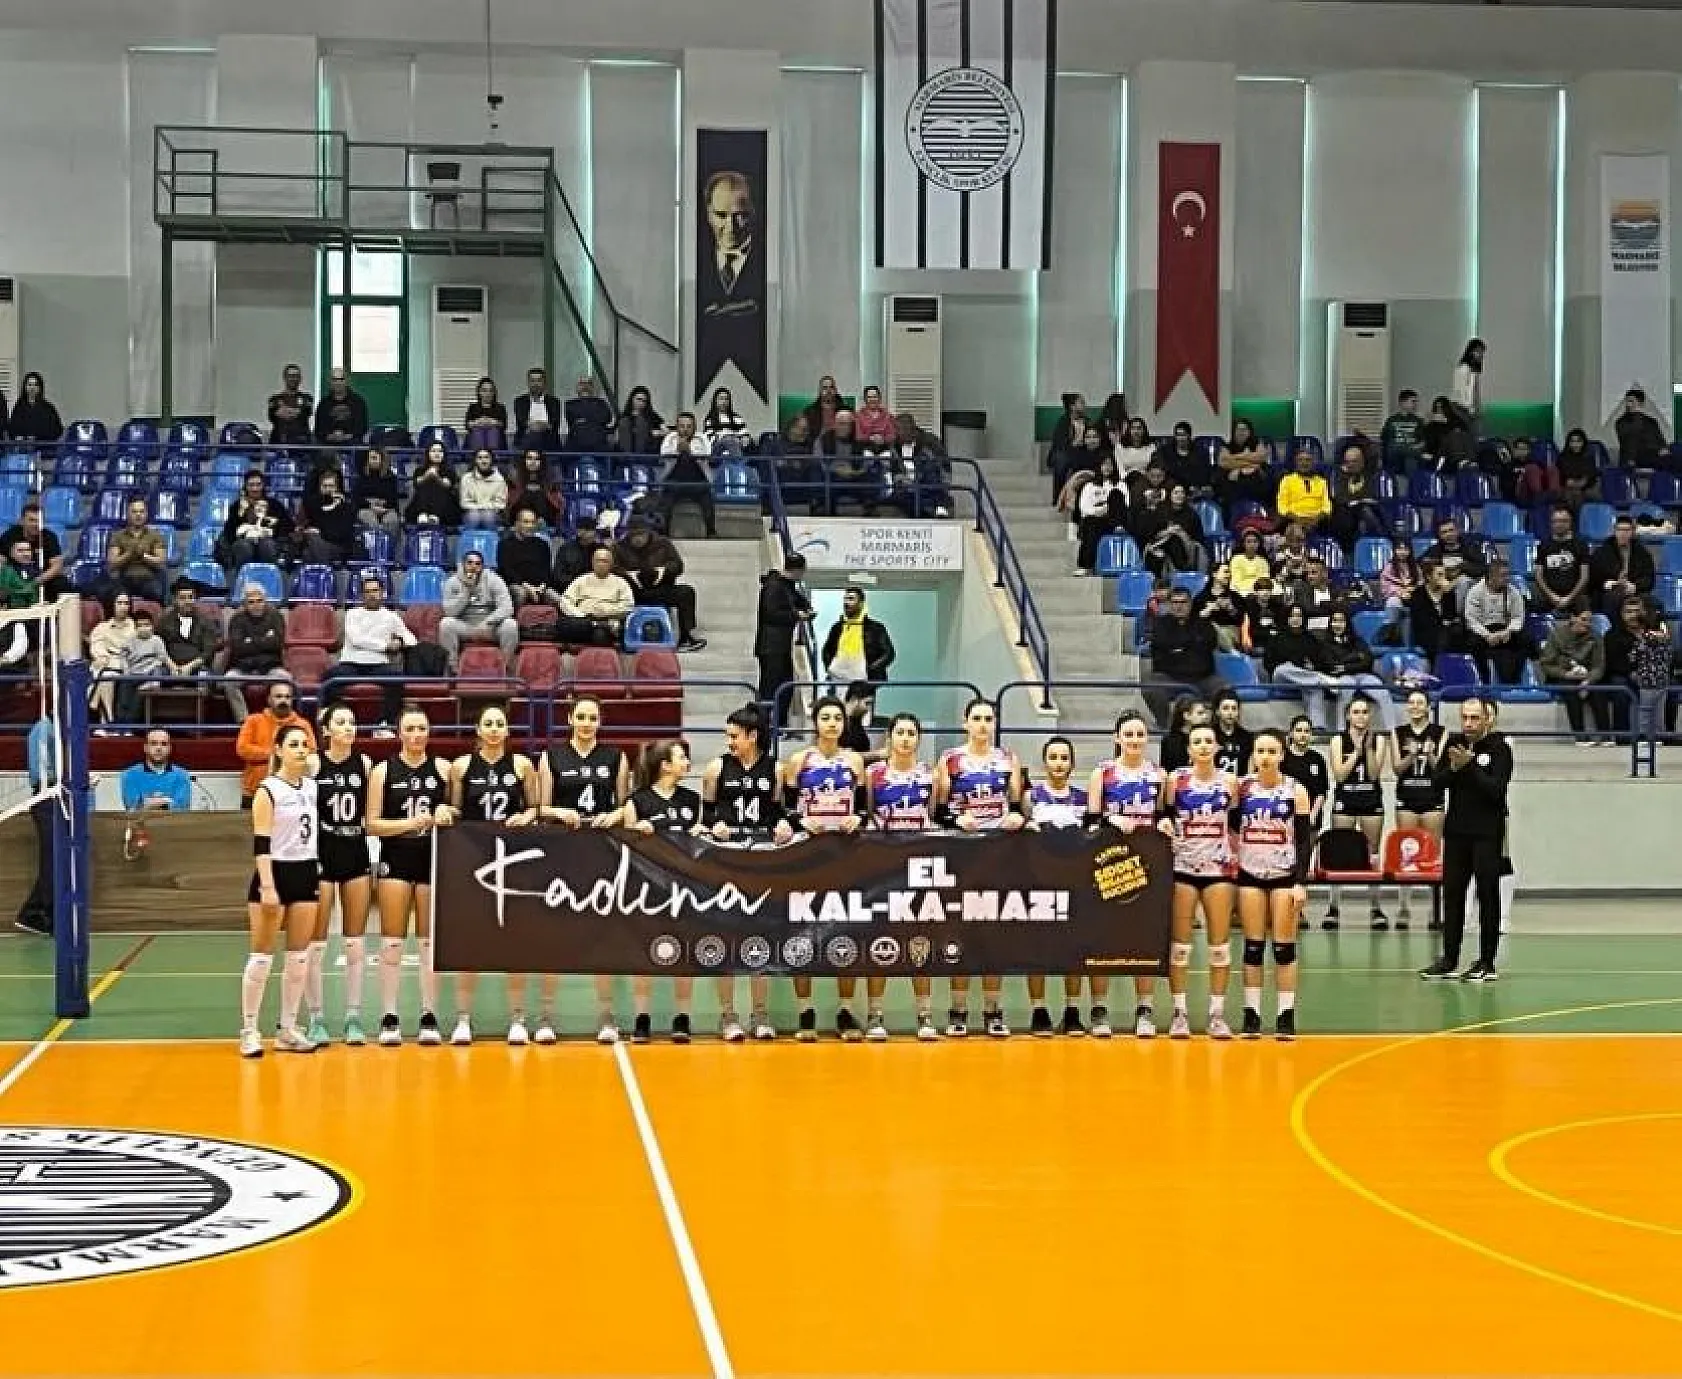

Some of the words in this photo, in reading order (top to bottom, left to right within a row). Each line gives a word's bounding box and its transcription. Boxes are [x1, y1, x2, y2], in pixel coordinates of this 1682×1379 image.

[326, 792, 357, 823] 10
[478, 791, 509, 821] 12
[577, 783, 597, 812] 4
[732, 795, 760, 823] 14
[300, 813, 312, 839] 3
[908, 856, 957, 888] EL
[788, 890, 1070, 922] KAL-KA-MAZ!
